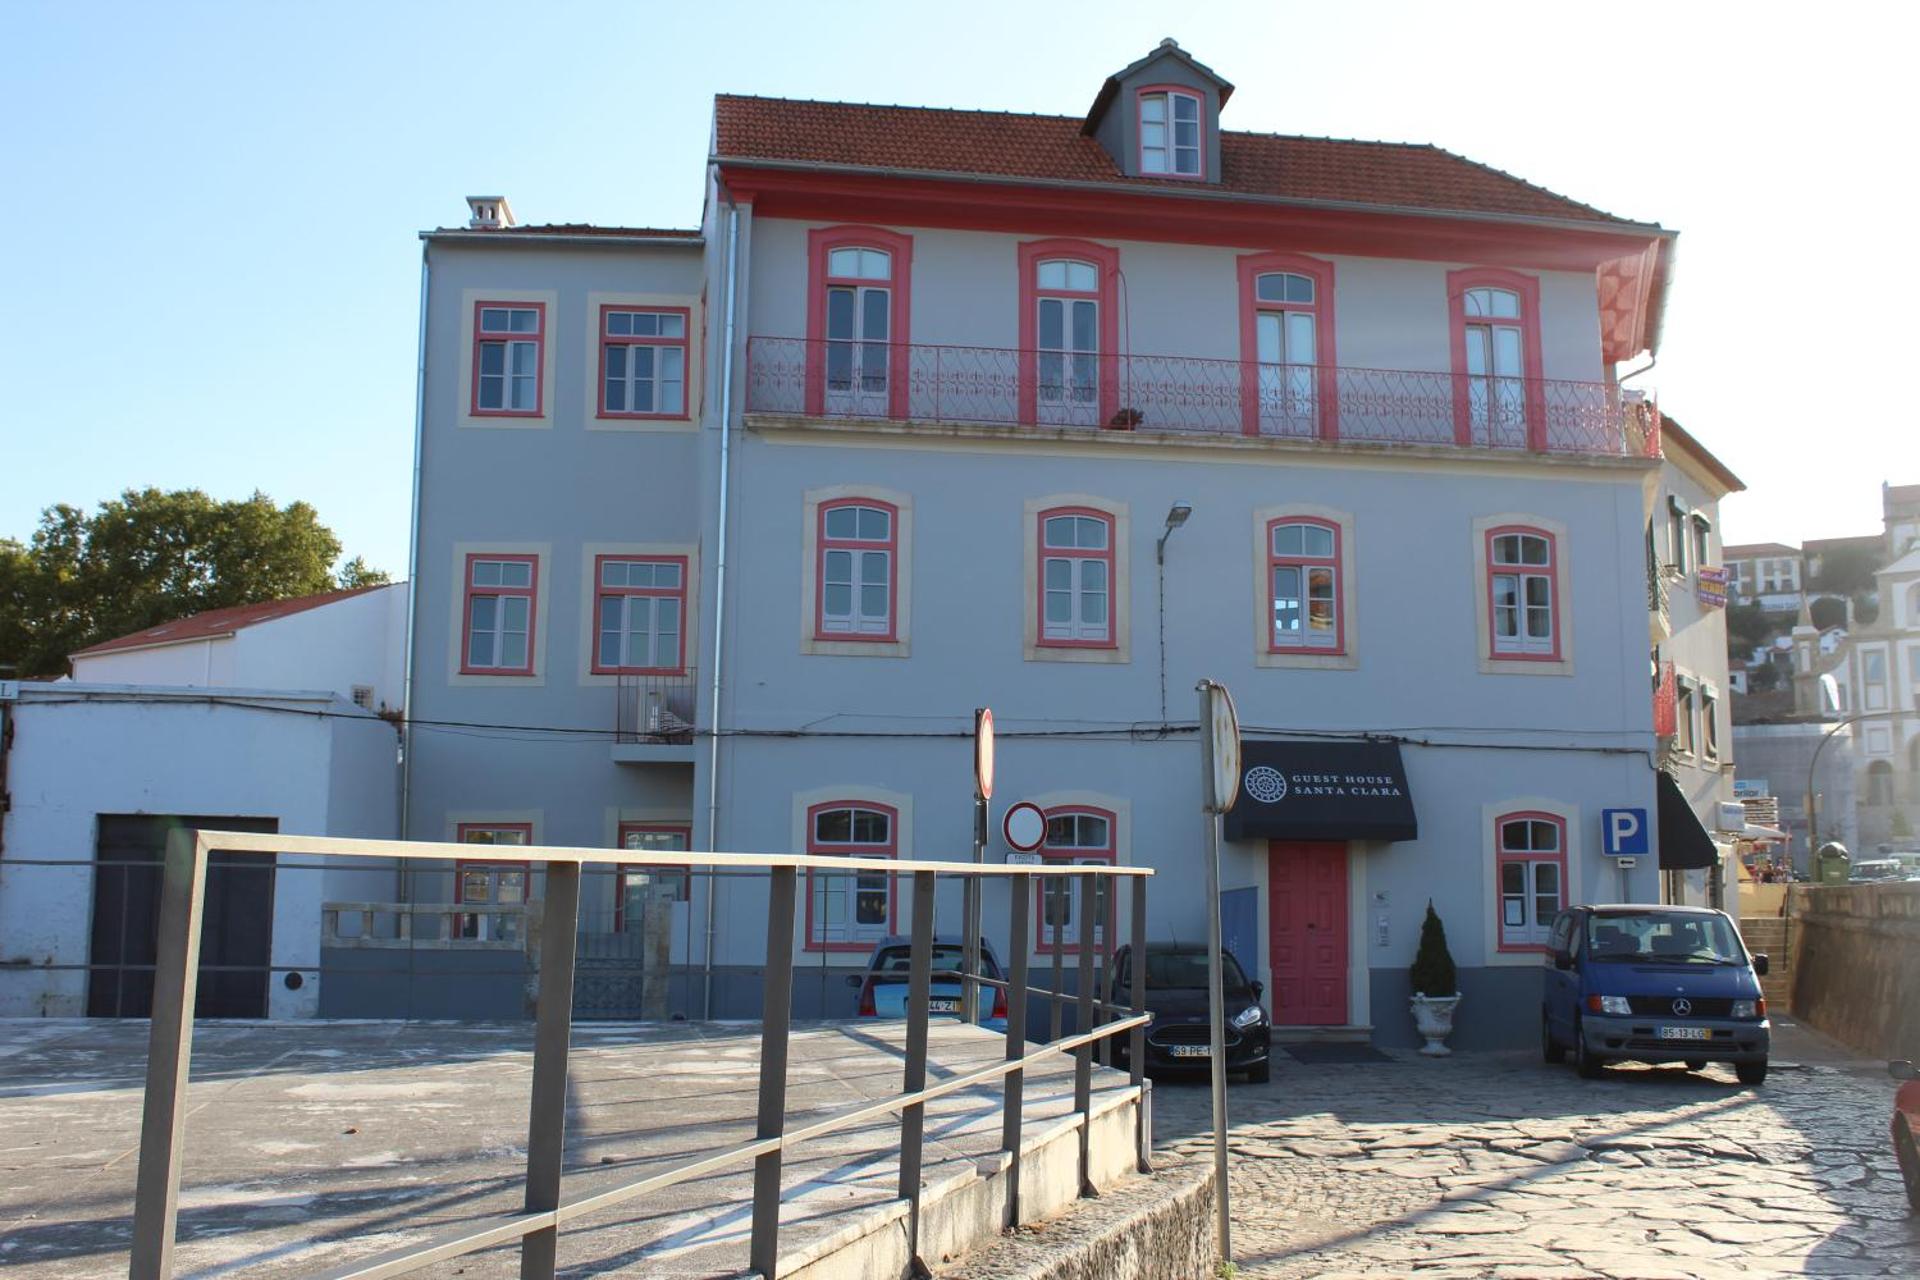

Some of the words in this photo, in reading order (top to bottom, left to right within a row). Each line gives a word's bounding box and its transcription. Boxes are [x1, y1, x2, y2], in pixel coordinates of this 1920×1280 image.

[1292, 775, 1340, 783] GUEST
[1345, 776, 1393, 784] HOUSE
[1294, 786, 1345, 795] SANTA
[1351, 787, 1401, 796] CLARA
[1611, 812, 1639, 851] P
